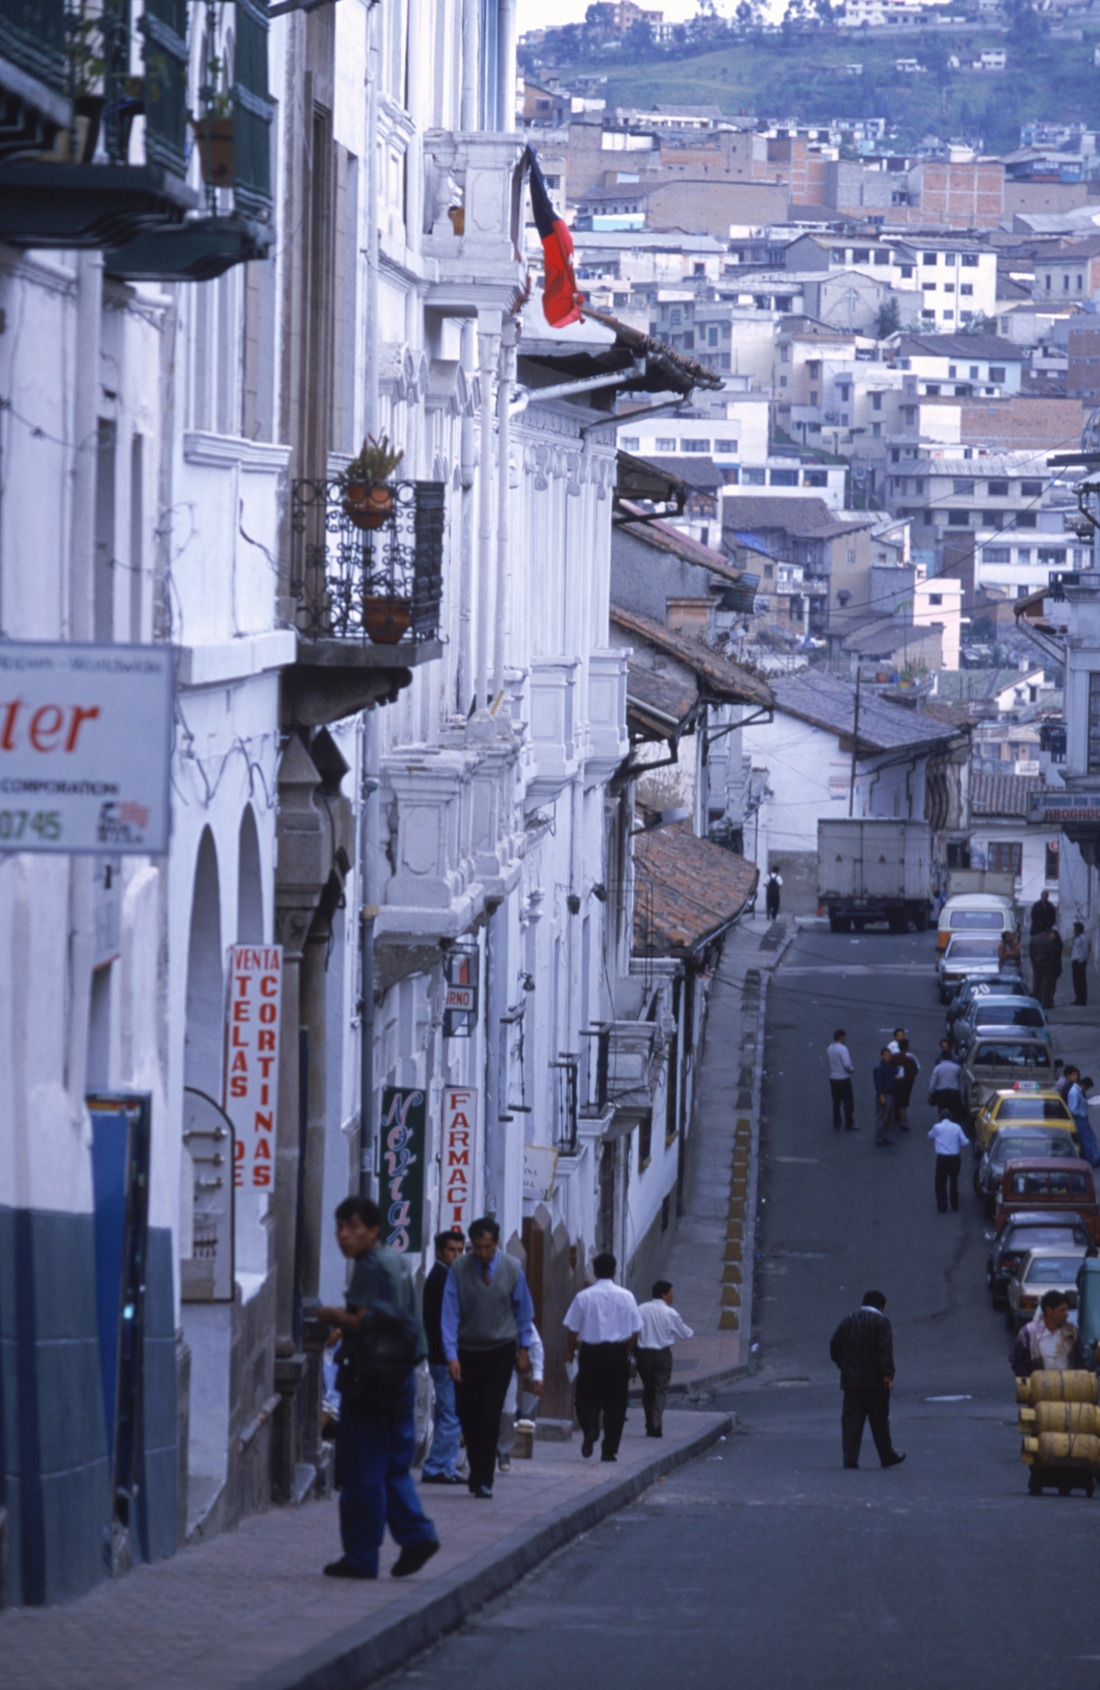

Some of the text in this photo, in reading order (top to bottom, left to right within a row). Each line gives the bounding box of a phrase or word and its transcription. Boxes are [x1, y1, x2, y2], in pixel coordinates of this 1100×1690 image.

[234, 948, 280, 971] VENTA
[971, 983, 991, 1000] 20
[230, 975, 251, 1098] TELAS
[252, 975, 278, 1187] CORTINAS
